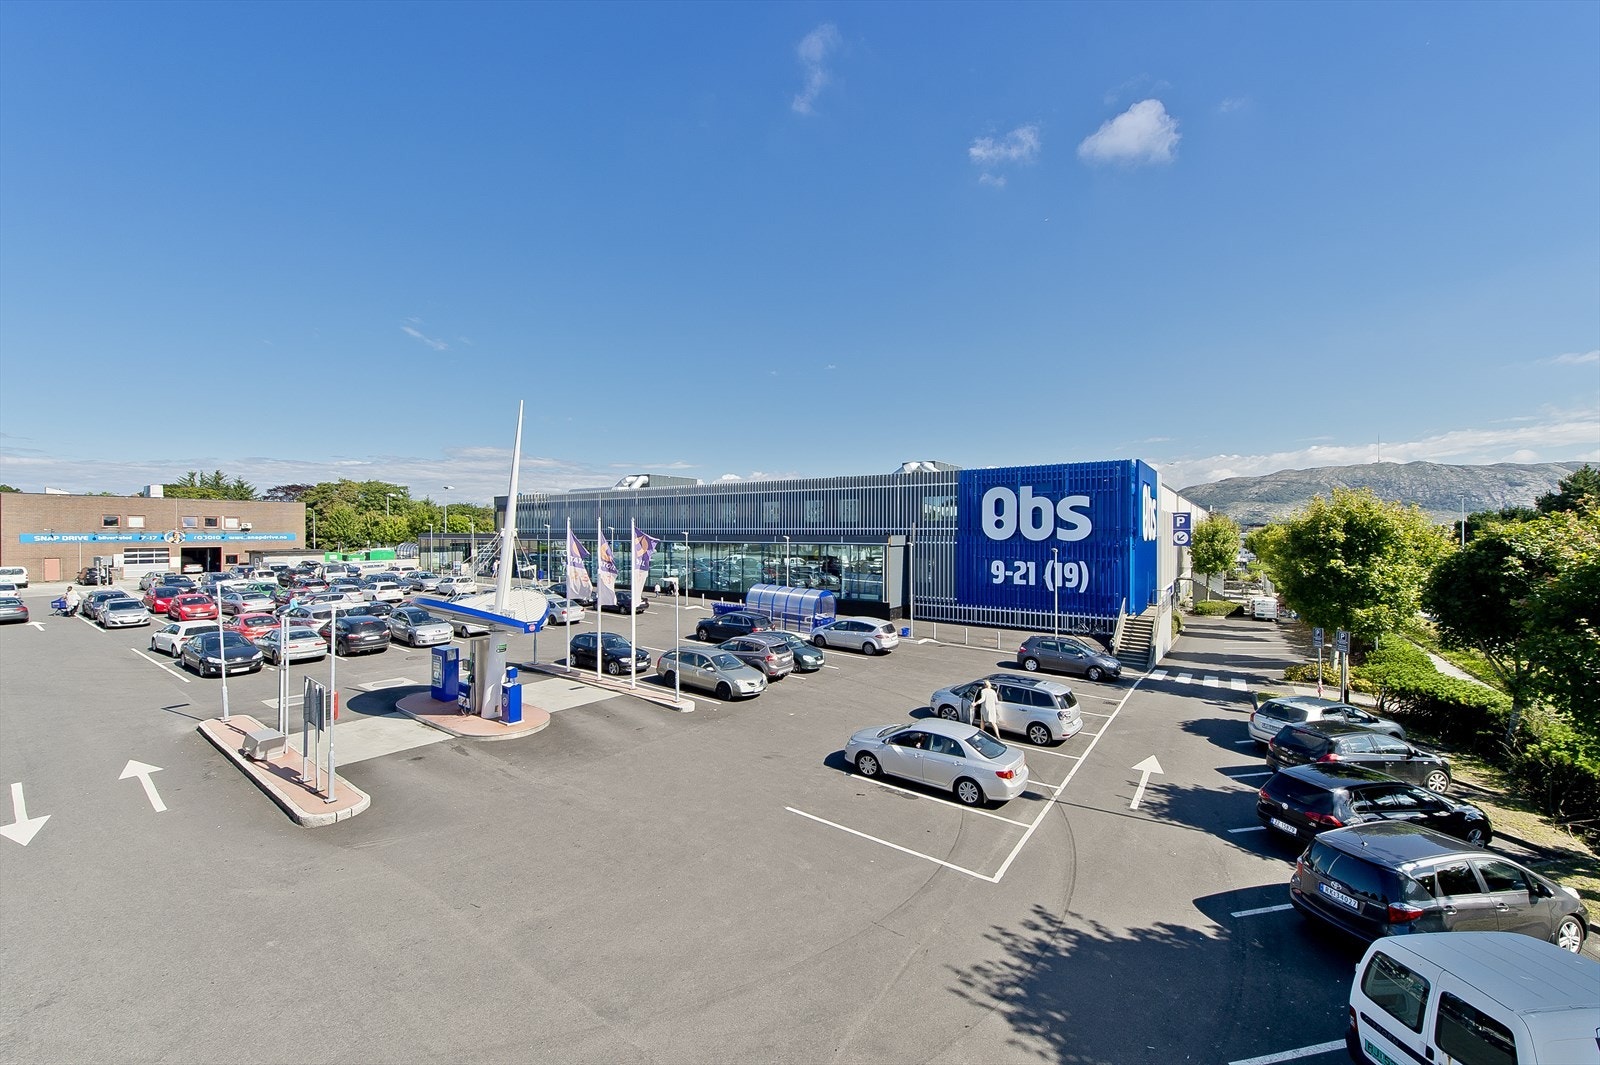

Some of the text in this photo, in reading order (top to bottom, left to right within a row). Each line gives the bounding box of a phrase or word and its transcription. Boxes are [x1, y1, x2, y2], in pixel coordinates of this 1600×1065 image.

[981, 485, 1092, 541] Obs
[1176, 516, 1186, 527] P
[990, 560, 1090, 593] 9-21 (19)
